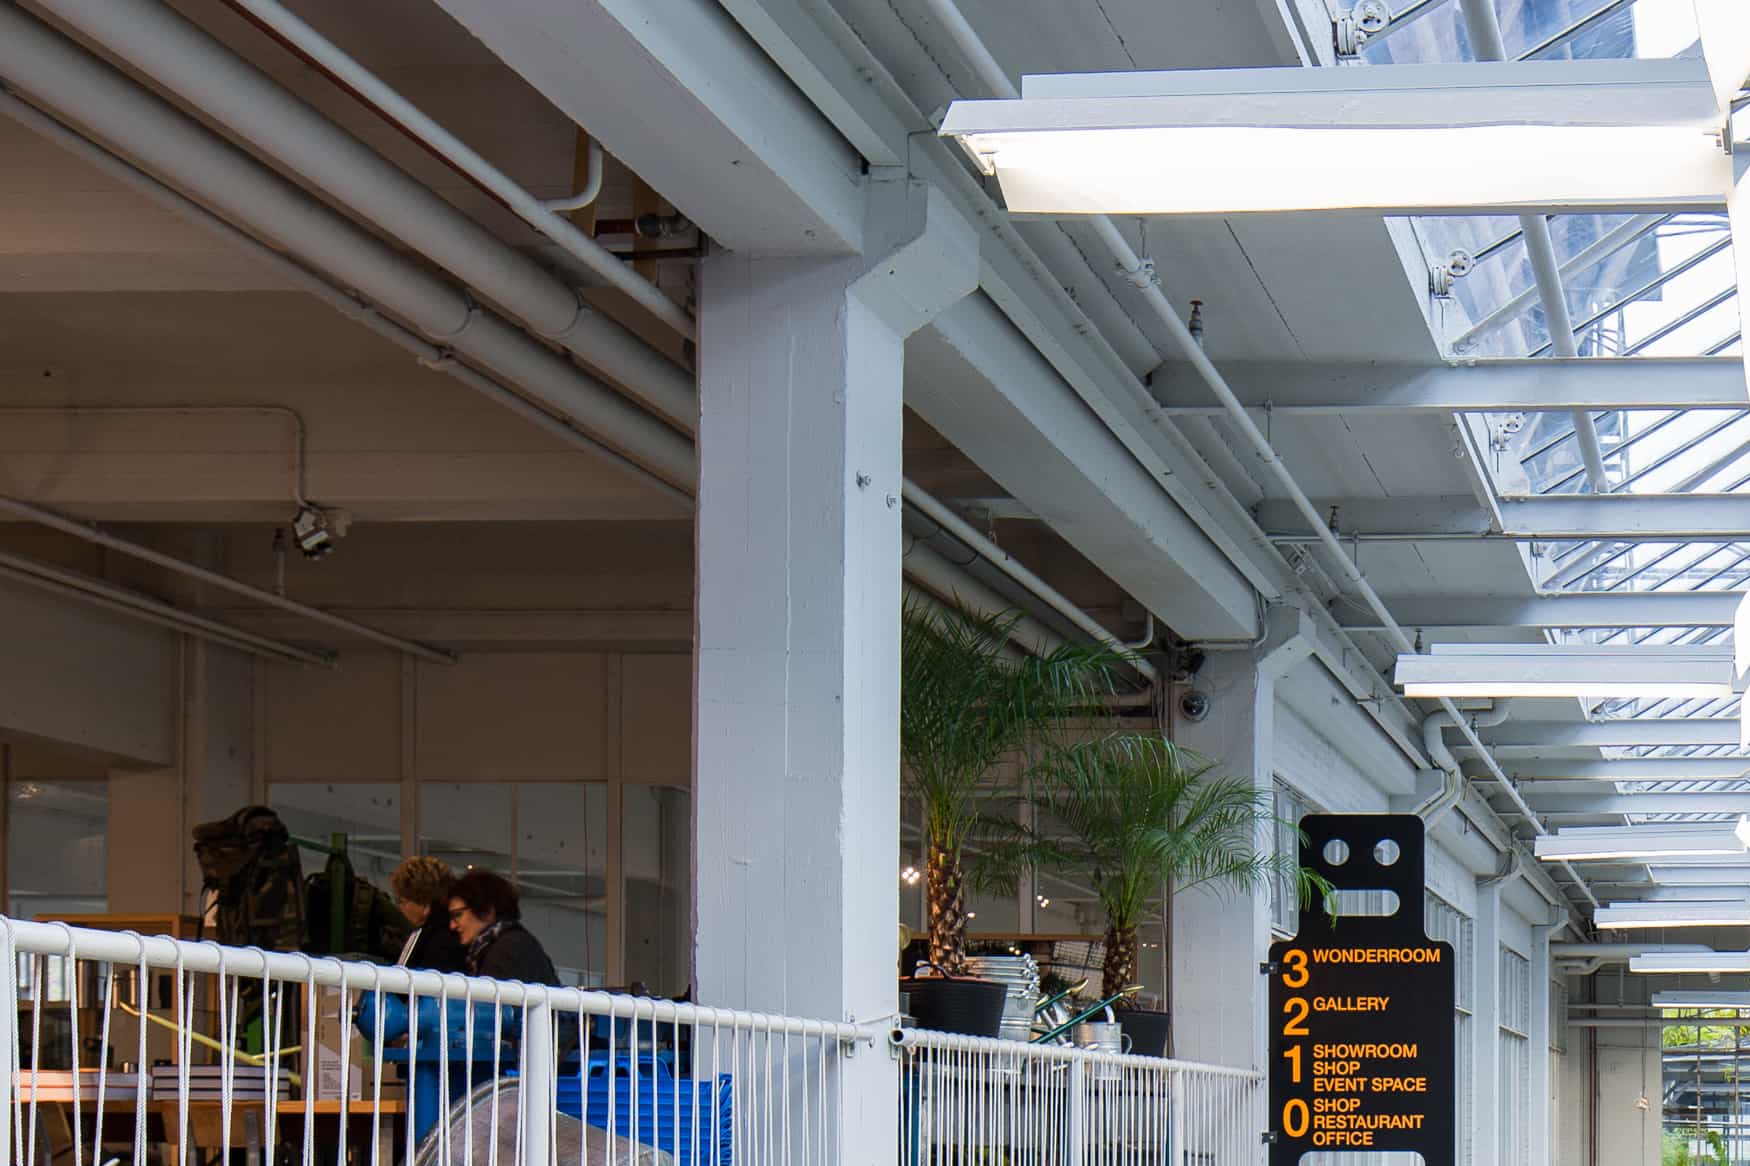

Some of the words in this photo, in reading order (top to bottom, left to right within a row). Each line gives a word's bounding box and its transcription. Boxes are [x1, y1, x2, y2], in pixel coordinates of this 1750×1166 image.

[1282, 948, 1310, 989] 3
[1312, 948, 1441, 964] WONDERROOM
[1283, 996, 1310, 1036] 2
[1312, 996, 1390, 1012] GALLERY
[1283, 1044, 1301, 1083] 1
[1313, 1043, 1418, 1059] SHOWROOM
[1312, 1060, 1361, 1076] SHOP
[1313, 1077, 1368, 1092] EVENT
[1371, 1077, 1427, 1092] SPACE
[1282, 1098, 1310, 1138] 0
[1313, 1097, 1361, 1113] SHOP
[1313, 1114, 1425, 1129] RESTAURANT
[1312, 1131, 1374, 1146] OFFICE
